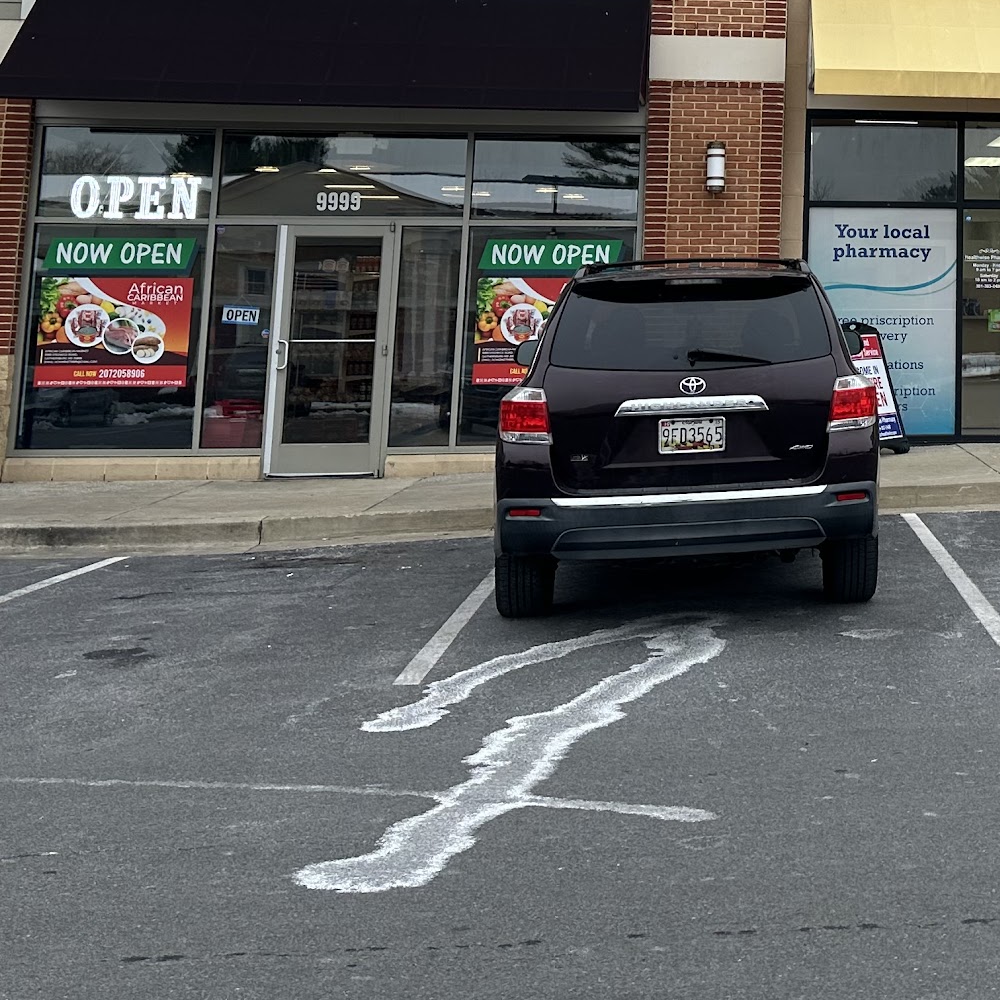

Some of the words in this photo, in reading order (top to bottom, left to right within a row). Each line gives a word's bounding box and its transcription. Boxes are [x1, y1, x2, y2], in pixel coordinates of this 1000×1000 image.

[70, 175, 202, 220] OPEN
[316, 191, 361, 212] 9999
[835, 224, 878, 239] Your
[883, 224, 930, 239] local
[55, 242, 113, 265] NOW
[120, 243, 182, 265] OPEN
[491, 244, 546, 265] NOW
[552, 243, 610, 265] OPEN
[832, 243, 932, 262] pharmacy
[128, 283, 184, 295] African
[127, 294, 184, 302] CARIBBEAN
[226, 309, 257, 322] OPEN
[860, 315, 935, 327] priscription
[98, 369, 145, 378] 2072058906
